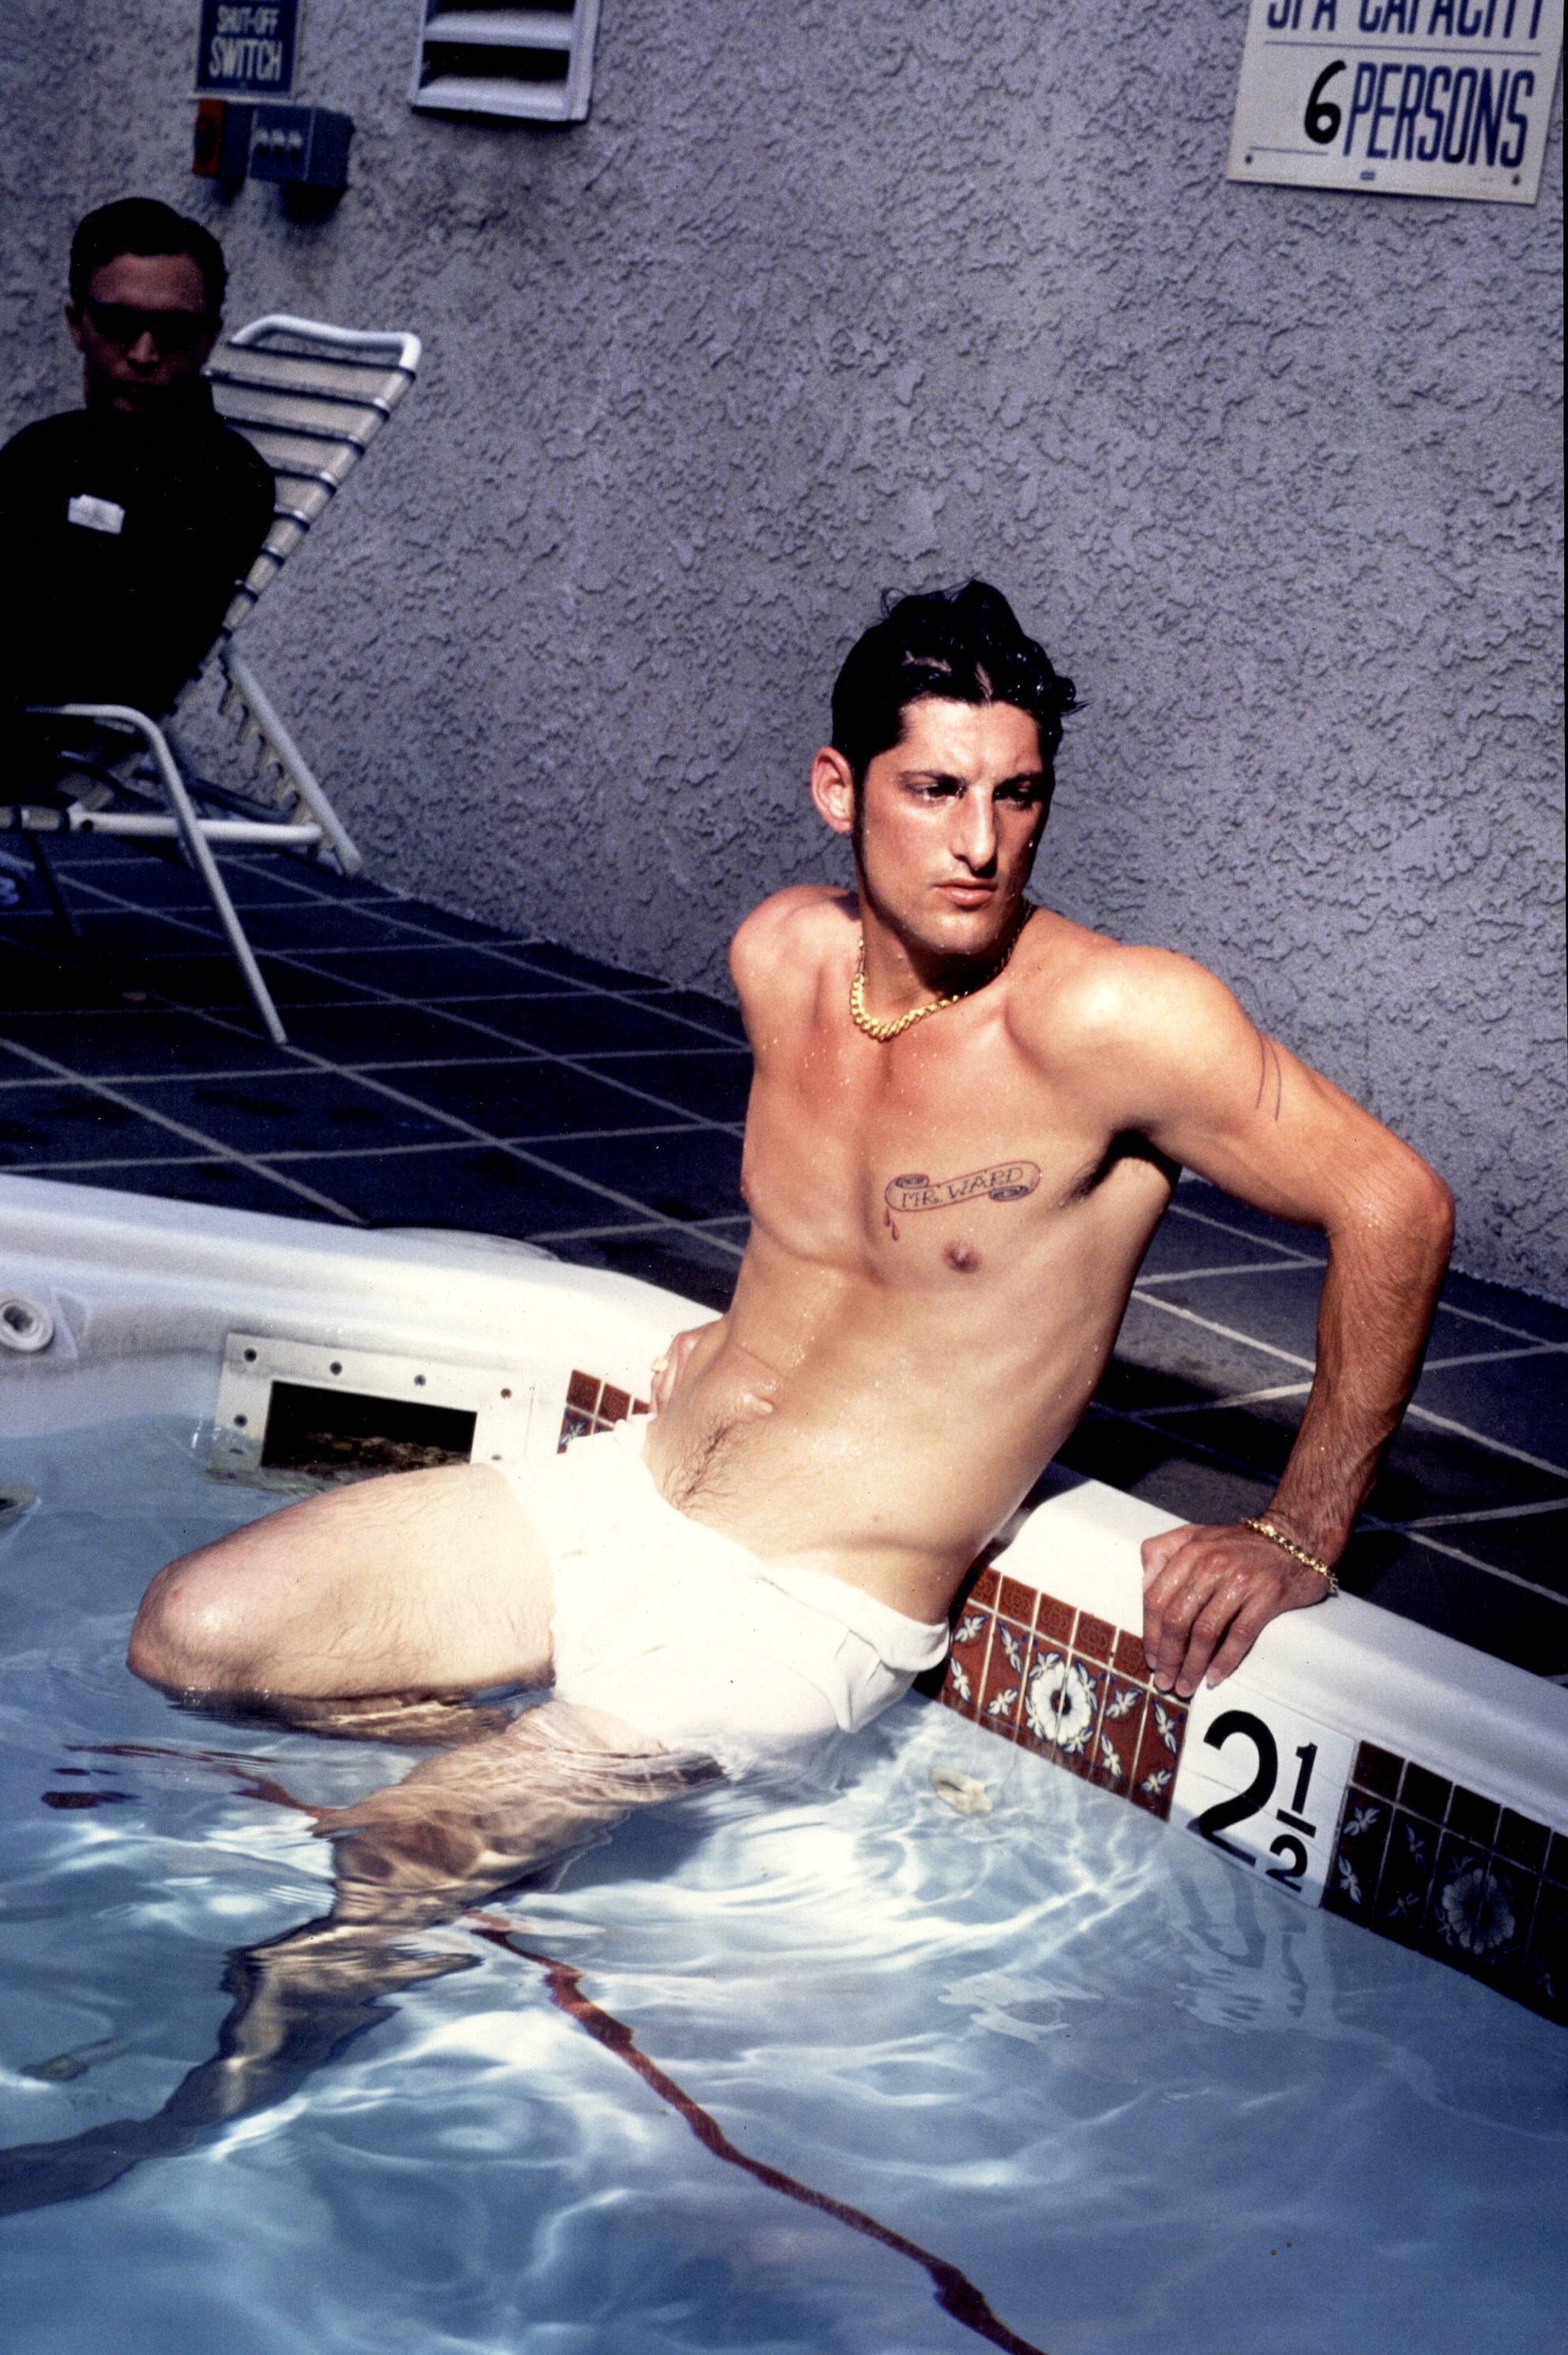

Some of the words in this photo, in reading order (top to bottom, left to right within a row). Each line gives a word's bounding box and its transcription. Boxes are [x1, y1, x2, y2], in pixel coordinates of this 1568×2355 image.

[209, 36, 283, 81] SWITCH
[1304, 60, 1347, 144] 6
[1343, 61, 1536, 167] PERSONS
[947, 1167, 1024, 1198] WARD
[1186, 1710, 1278, 1867] 2
